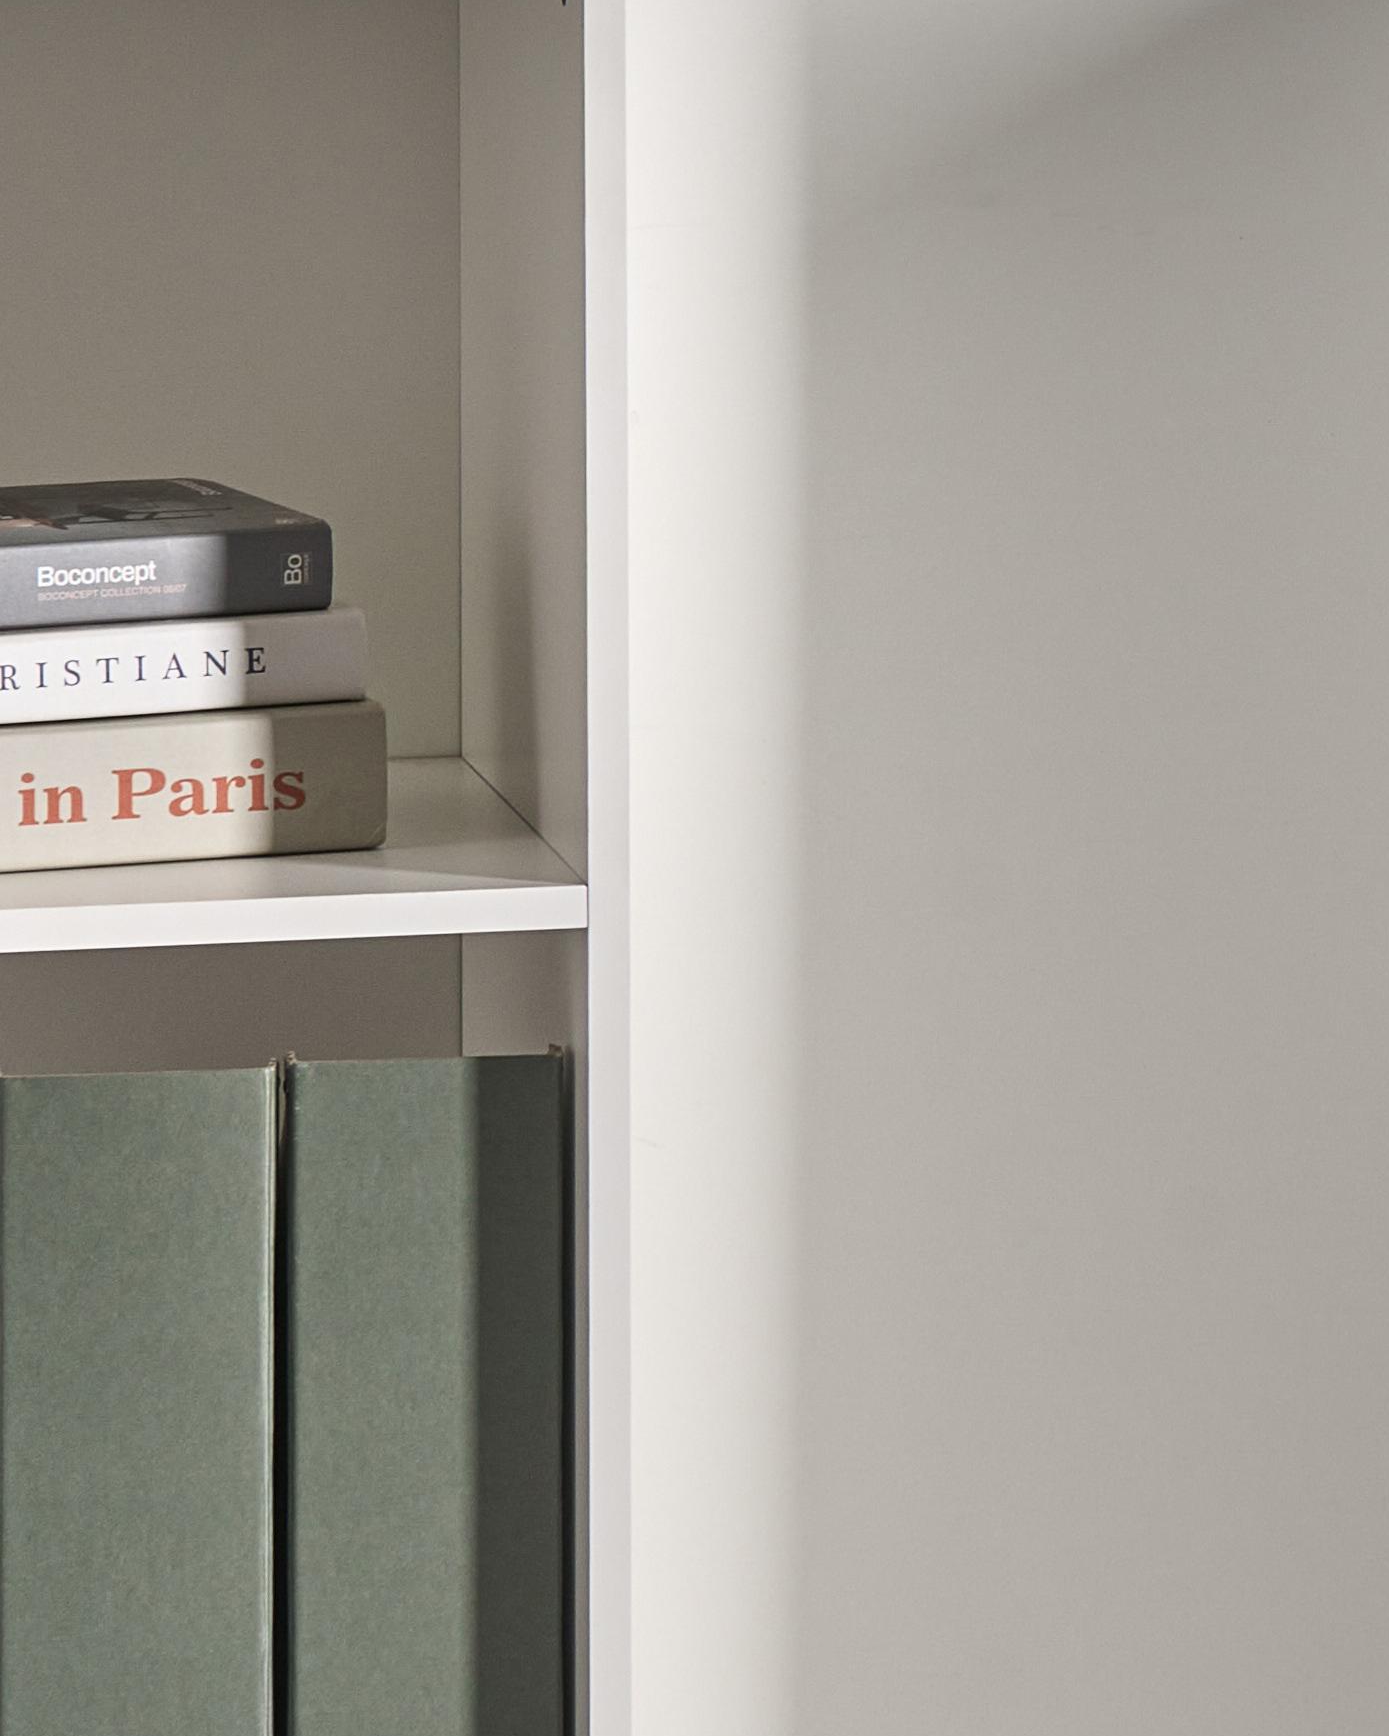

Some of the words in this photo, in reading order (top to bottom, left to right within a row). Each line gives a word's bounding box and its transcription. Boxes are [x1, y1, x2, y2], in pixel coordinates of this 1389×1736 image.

[37, 560, 157, 588] Boconcept
[284, 554, 302, 584] Bo
[37, 590, 99, 601] BOCONCEPT
[101, 586, 161, 597] COLLECTION
[0, 647, 267, 691] RISTIANE
[18, 772, 88, 827] in
[111, 758, 307, 821] Paris
